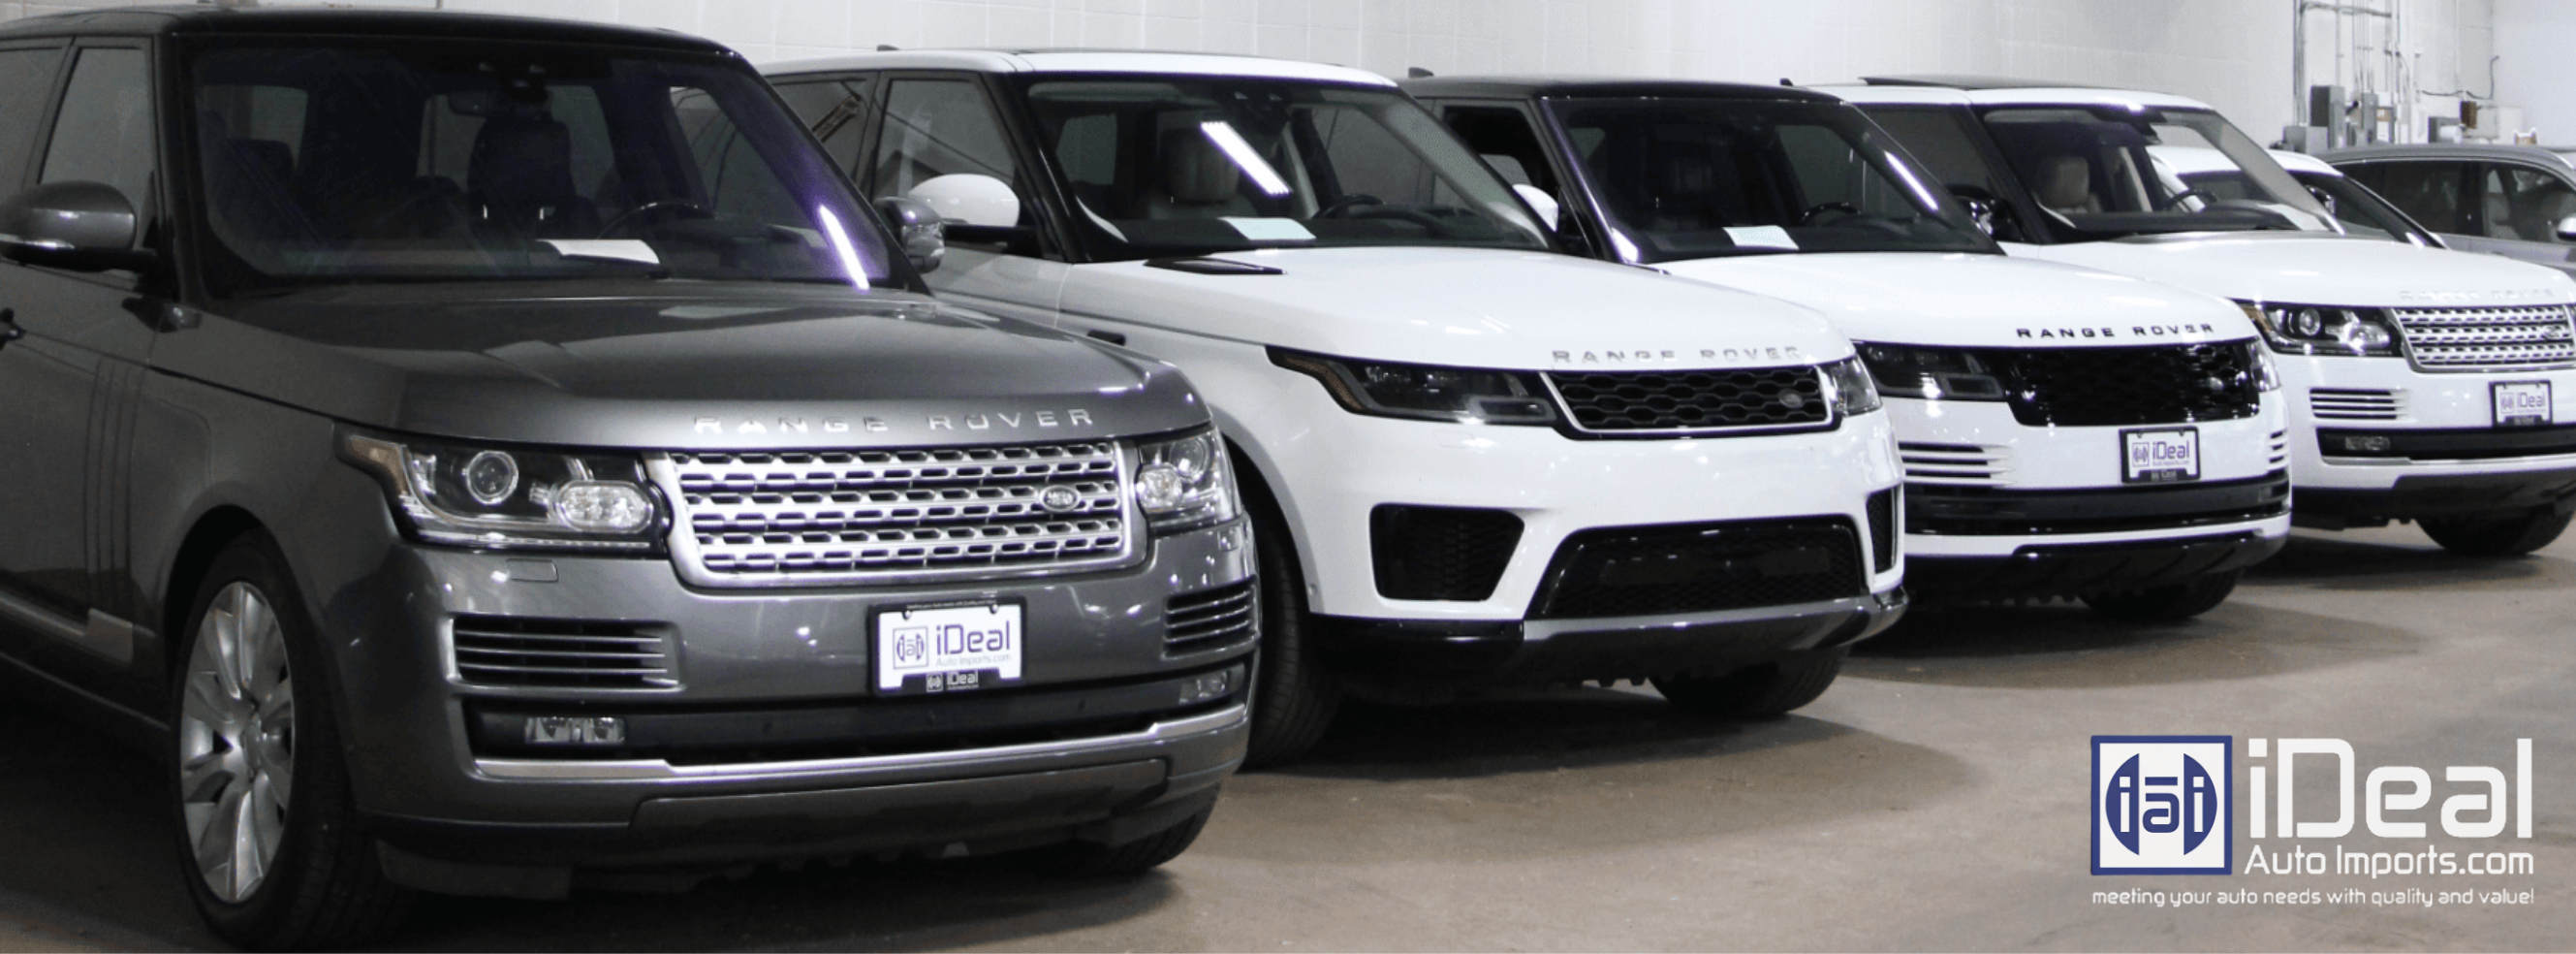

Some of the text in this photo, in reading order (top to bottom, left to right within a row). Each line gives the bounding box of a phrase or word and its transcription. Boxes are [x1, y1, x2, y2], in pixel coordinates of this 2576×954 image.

[2016, 323, 2215, 338] RANGE ROVER
[1552, 346, 1802, 364] RANGE ROVER
[694, 408, 1094, 434] RANGE ROVER
[2152, 439, 2190, 460] iDeal
[935, 620, 1011, 655] iDeal
[935, 656, 958, 667] Auto
